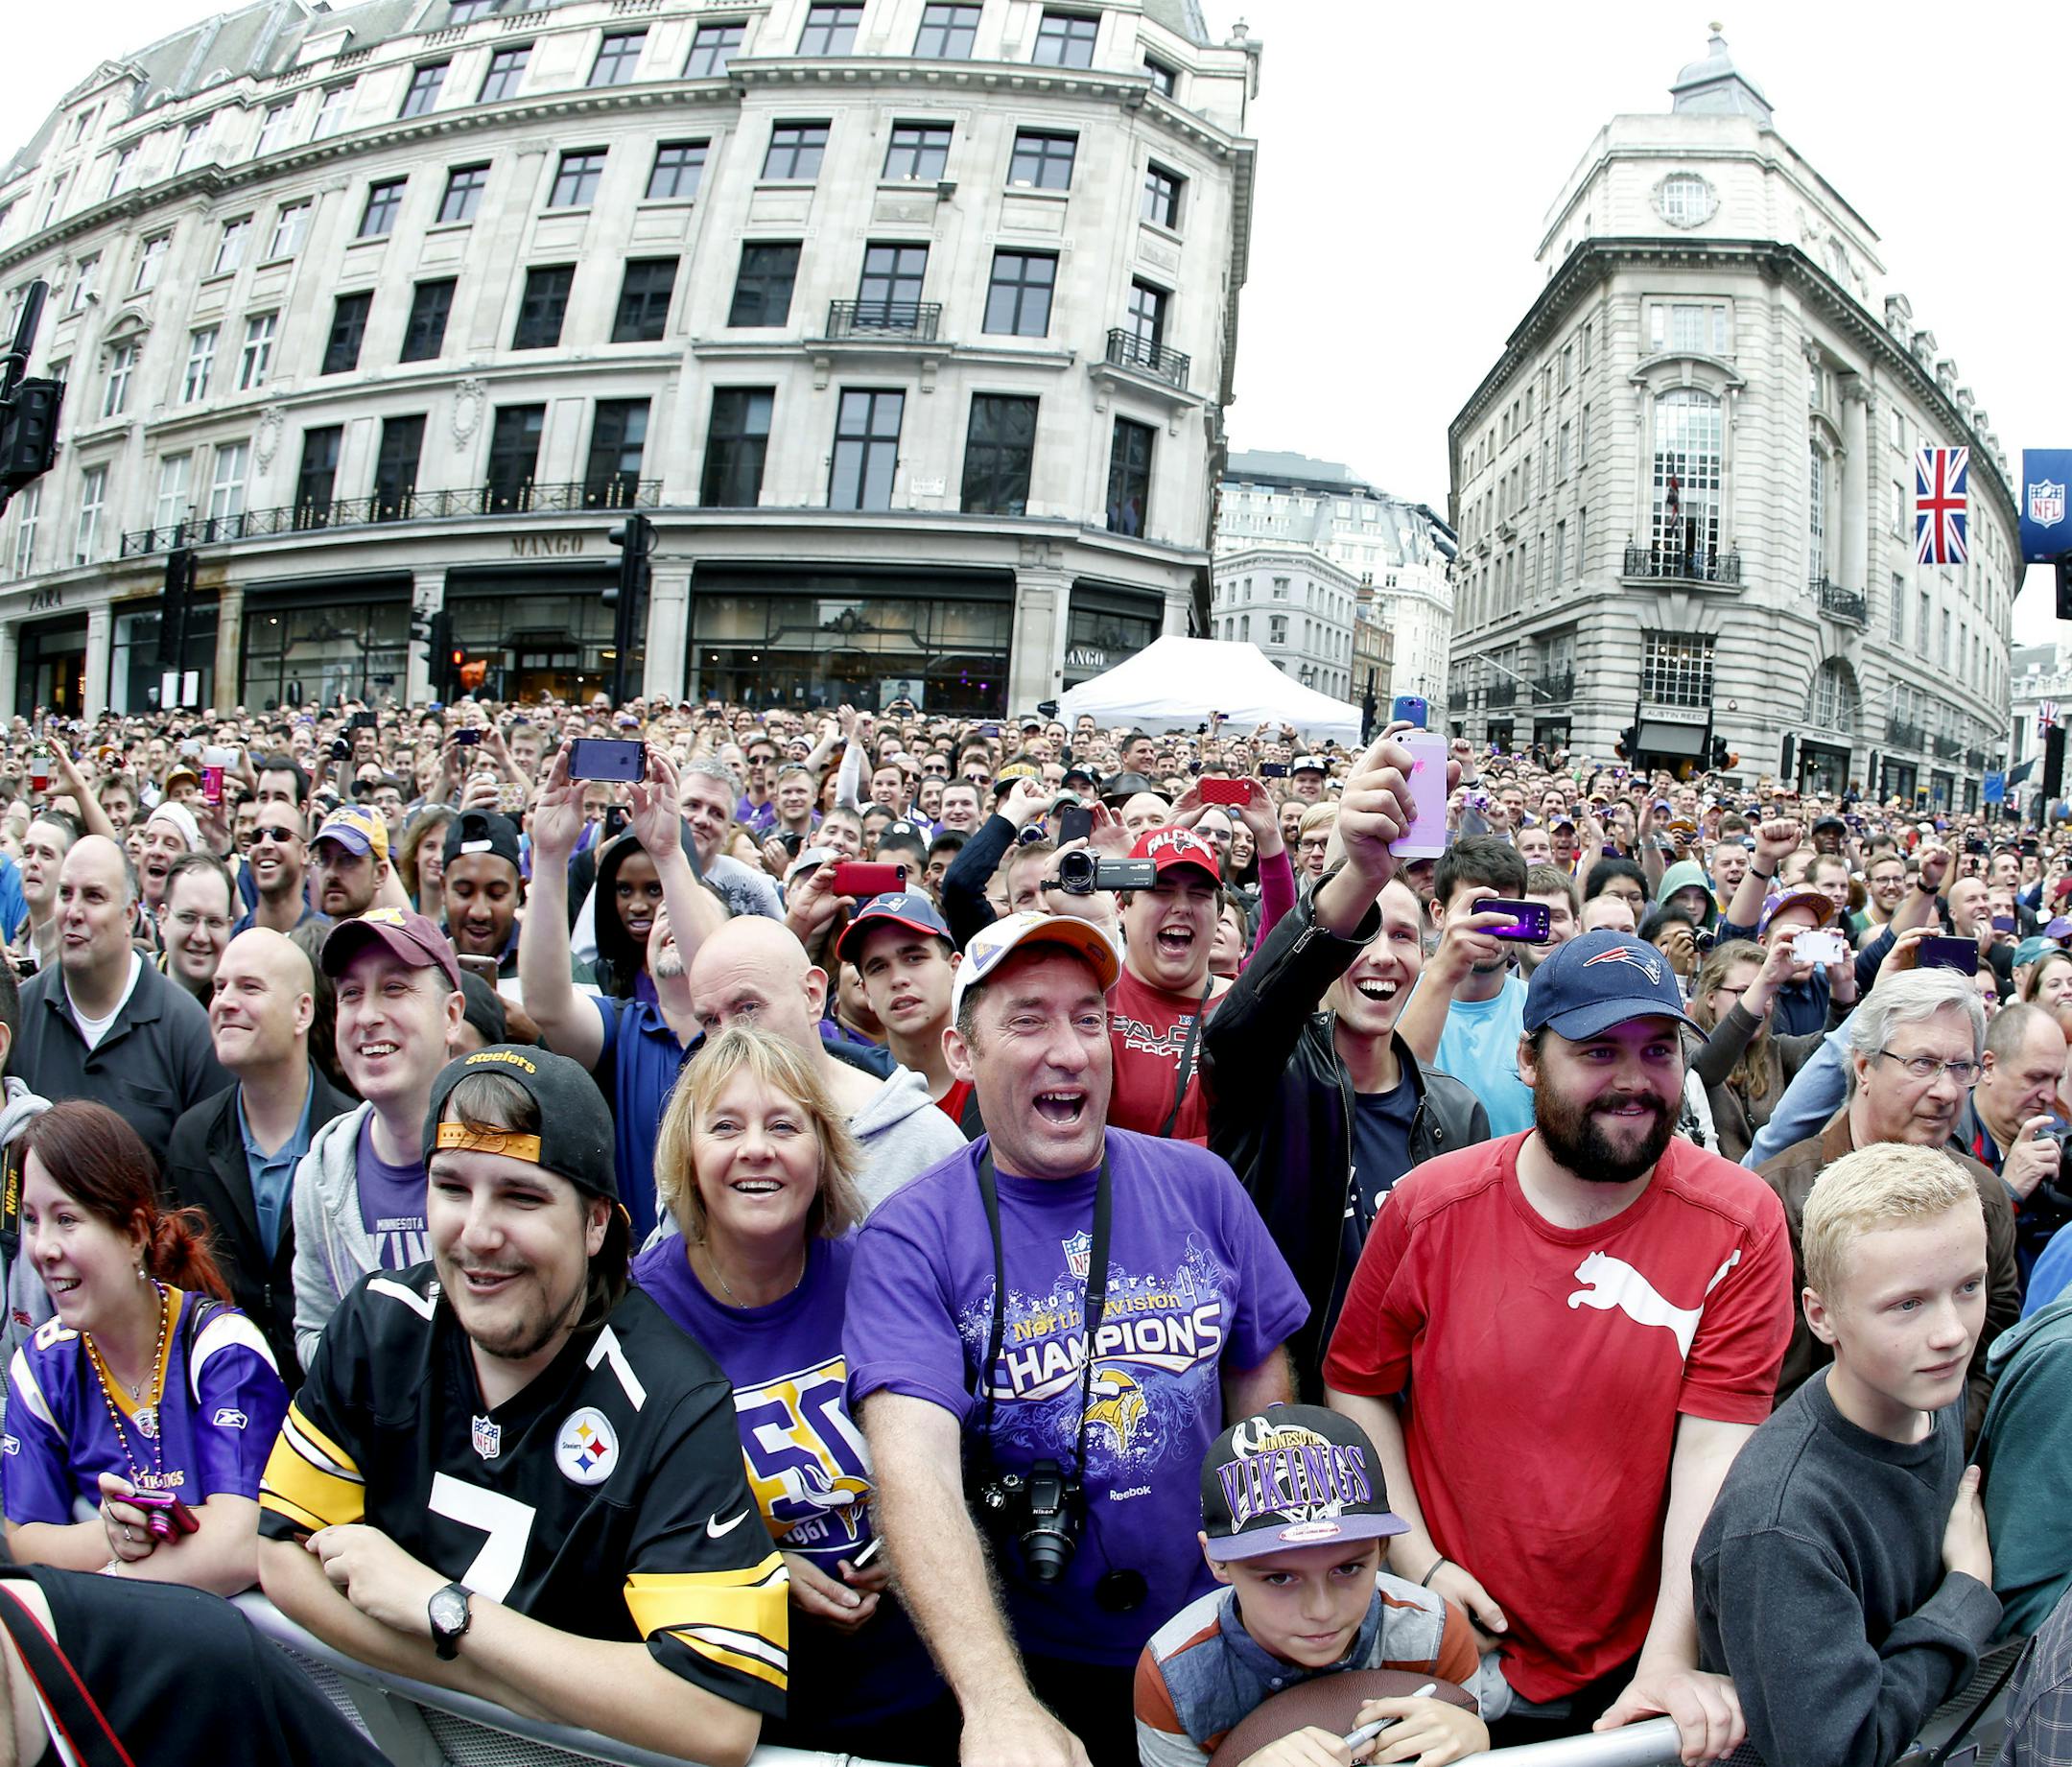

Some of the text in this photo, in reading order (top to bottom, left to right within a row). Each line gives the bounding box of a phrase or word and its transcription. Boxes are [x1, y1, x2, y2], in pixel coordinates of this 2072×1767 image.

[2034, 500, 2060, 518] NFL
[510, 536, 583, 556] MANGO
[28, 586, 62, 611] ZARA
[1064, 649, 1104, 666] ANGO
[1647, 710, 1705, 721] AUSTIN REED
[5, 1168, 18, 1216] Nikon
[376, 1216, 424, 1232] MINNESOTA
[1072, 1252, 1091, 1274] NF
[1108, 1275, 1157, 1292] NFC
[1012, 1291, 1183, 1342] North ivision
[982, 1303, 1222, 1400] CHAMPIONS
[475, 1431, 496, 1453] NFL
[1258, 1431, 1321, 1453] MINNESOTA
[1109, 1485, 1151, 1501] Reebok
[1215, 1444, 1375, 1524] VIKINGS
[428, 1471, 537, 1605] 7
[782, 1518, 830, 1545] 1961
